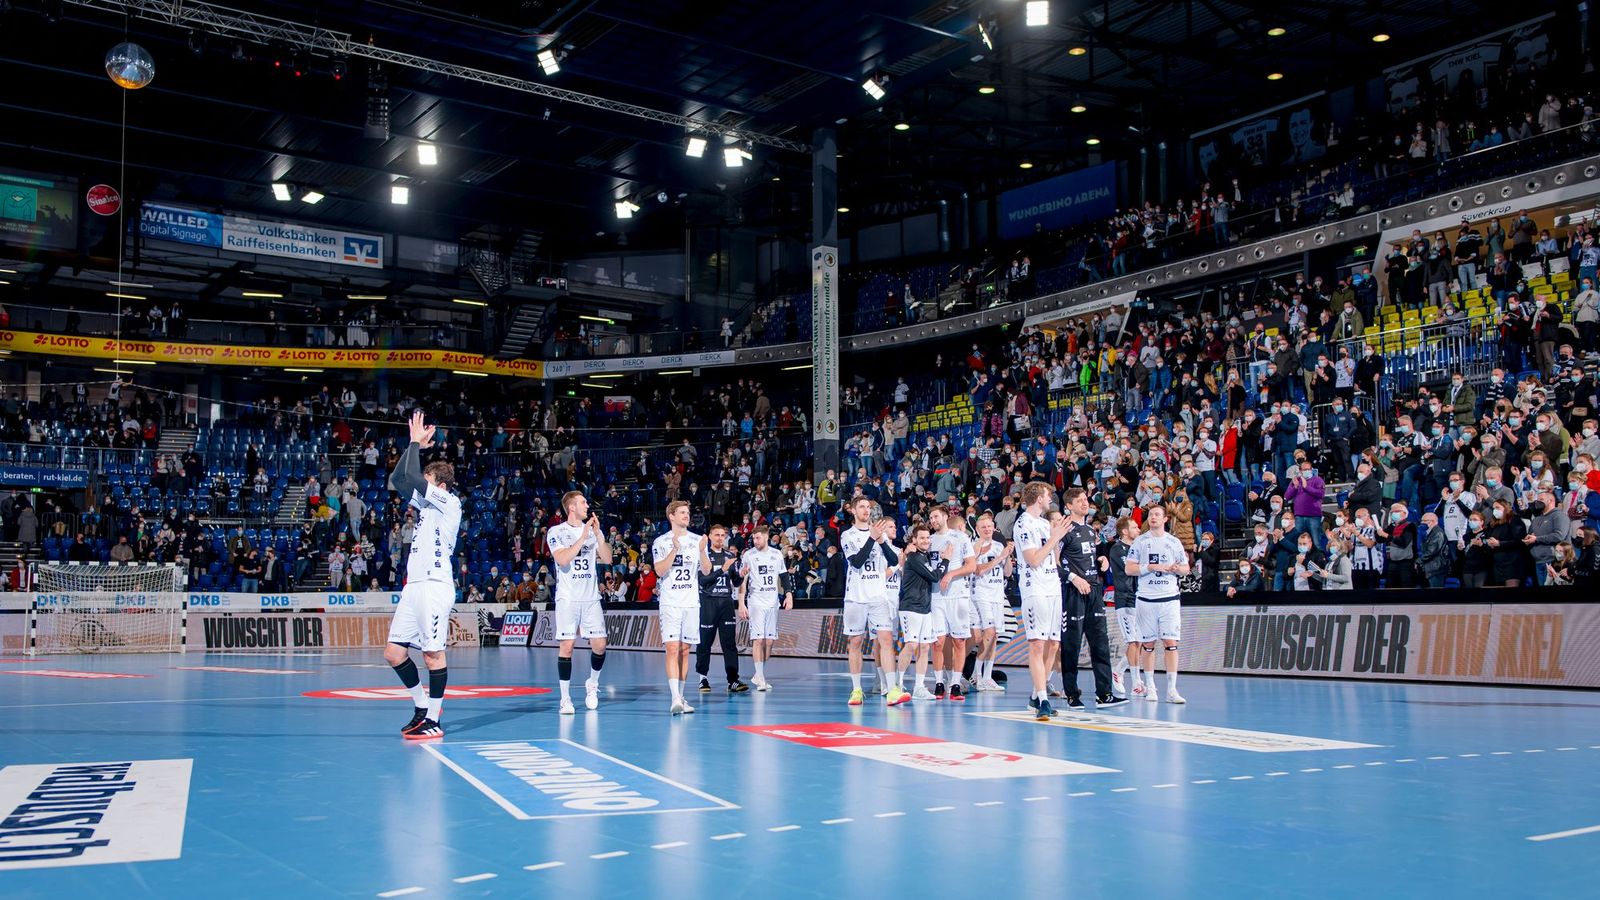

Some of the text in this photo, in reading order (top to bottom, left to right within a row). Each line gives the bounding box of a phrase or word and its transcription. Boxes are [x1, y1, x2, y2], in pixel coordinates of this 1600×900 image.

[89, 194, 118, 206] Sinalco
[1008, 186, 1110, 222] WUNDERINO ARENA
[141, 209, 208, 229] WALLED
[140, 222, 207, 241] Digital Signage
[258, 224, 336, 245] Volksbanken
[227, 235, 336, 258] Raiffeisenbanken
[50, 337, 89, 348] LOTTO
[119, 342, 156, 353] LOTTO
[178, 346, 214, 357] LOTTO
[237, 350, 271, 359] LOTTO
[292, 350, 326, 360] LOTTO
[347, 352, 380, 361] LOTTO
[400, 352, 432, 361] LOTTO
[700, 353, 721, 361] DIERCK
[455, 355, 485, 365] LOTTO
[508, 361, 537, 370] LOTTO
[4, 472, 36, 480] beraten.
[574, 559, 589, 570] 53
[864, 561, 876, 572] 61
[675, 569, 690, 581] 23
[992, 567, 1000, 576] 17
[716, 576, 726, 586] 21
[763, 576, 773, 585] 18
[115, 595, 145, 605] DKB
[190, 595, 220, 606] DKB
[261, 596, 290, 606] DKB
[328, 595, 355, 605] DKB
[506, 615, 531, 624] LIQUI
[203, 612, 288, 648] WÜNSCHT
[292, 616, 323, 647] DER
[326, 616, 363, 646] THW
[504, 625, 530, 634] MOLY
[628, 615, 648, 646] DER
[1223, 605, 1566, 680] WÜNSCHT DER THW KIEL
[464, 742, 660, 810] WUNDERINO
[0, 762, 137, 862] walbusch
